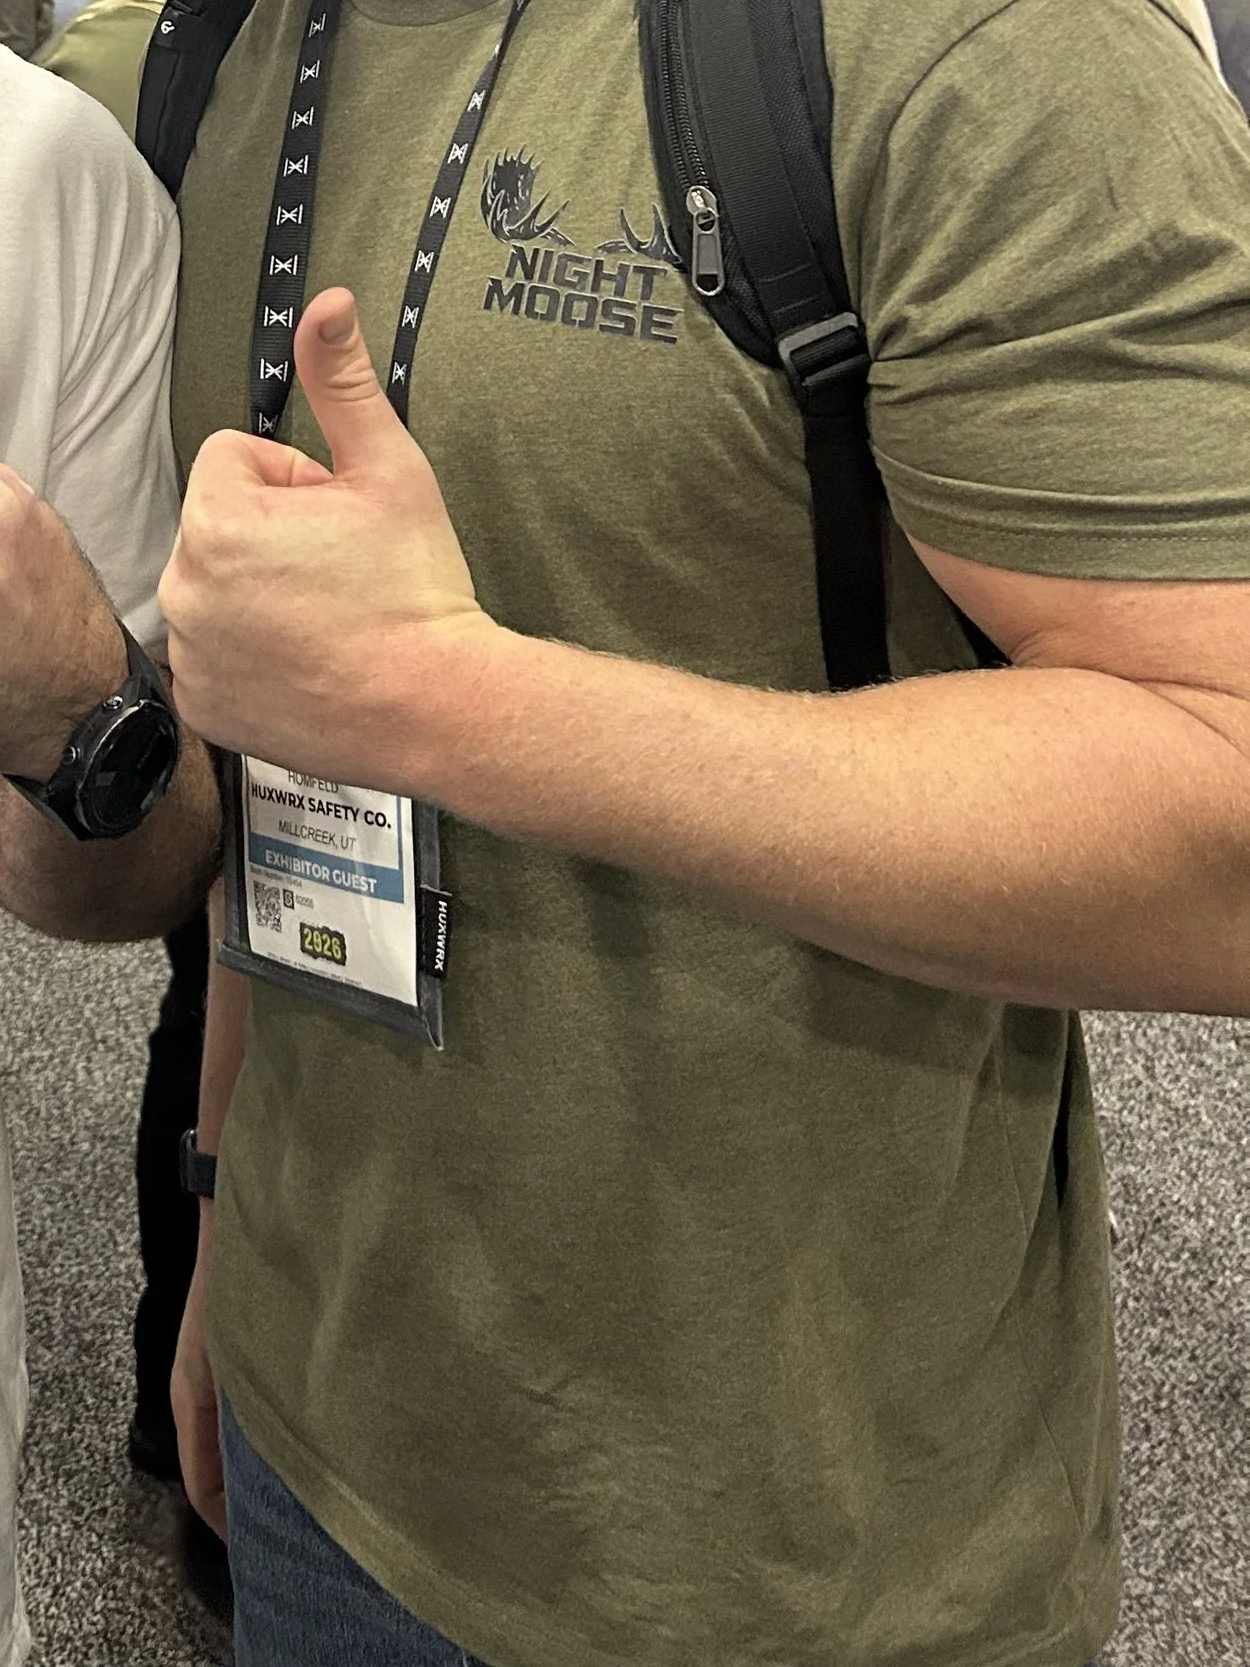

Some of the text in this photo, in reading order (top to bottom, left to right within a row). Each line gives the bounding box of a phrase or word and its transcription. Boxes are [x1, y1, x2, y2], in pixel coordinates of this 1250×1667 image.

[505, 243, 669, 302] NIGHT
[483, 277, 685, 345] MOOSE
[250, 782, 392, 830] HUXWRX SAFETY CO.
[277, 819, 357, 850] MILLCREEK, UT
[265, 849, 331, 882] EXHIBITOR
[333, 870, 378, 893] GUEST
[302, 928, 342, 959] 2026
[434, 899, 448, 971] HUXWRX
